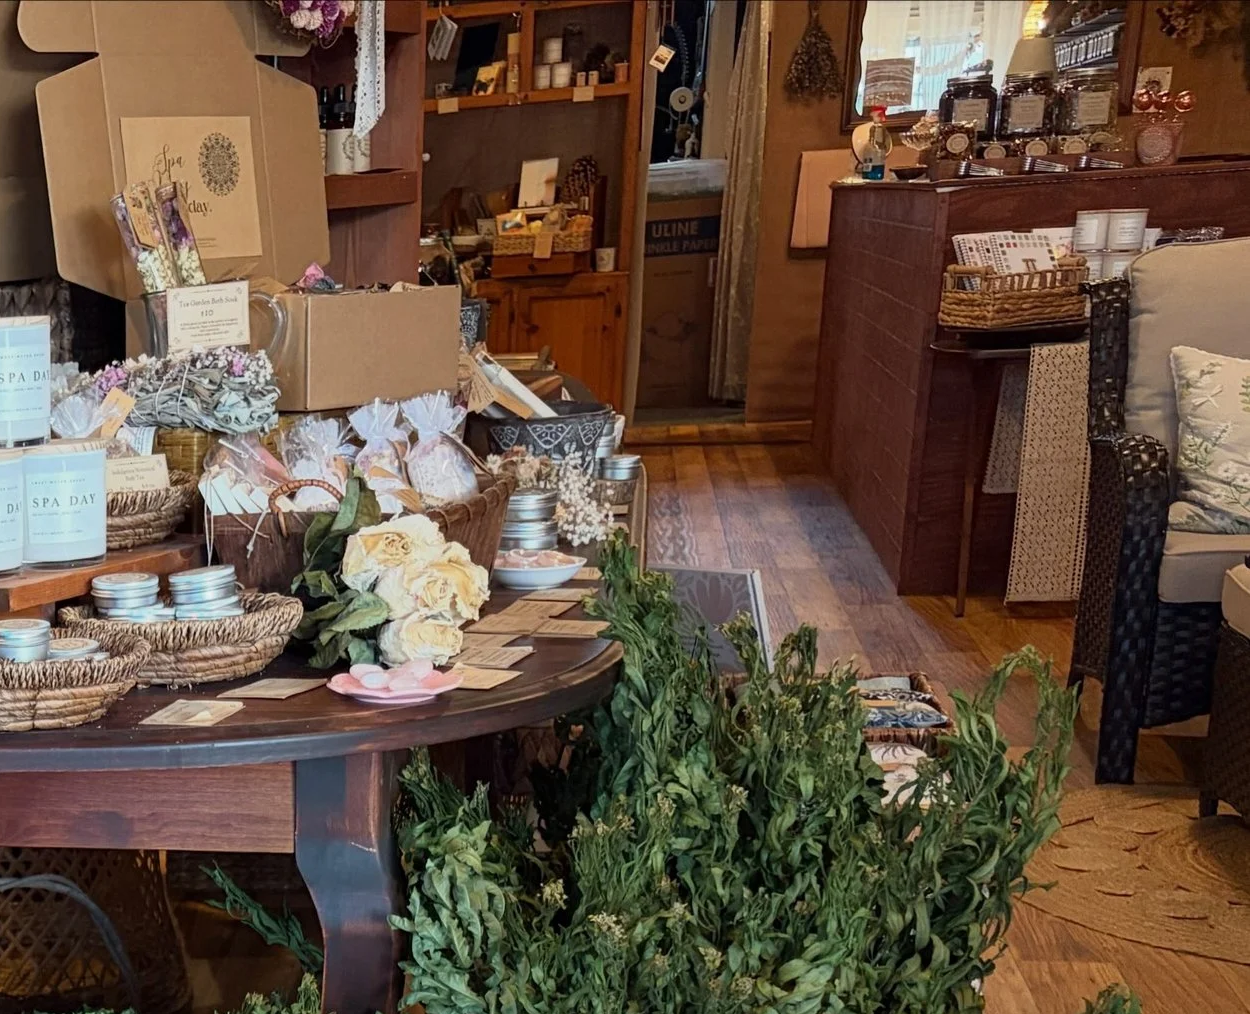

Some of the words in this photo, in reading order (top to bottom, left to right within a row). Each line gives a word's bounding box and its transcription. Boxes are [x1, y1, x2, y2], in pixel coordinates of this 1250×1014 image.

[651, 220, 699, 238] ULINE
[7, 501, 22, 515] DA
[32, 497, 60, 508] SPA
[69, 493, 96, 506] DAY
